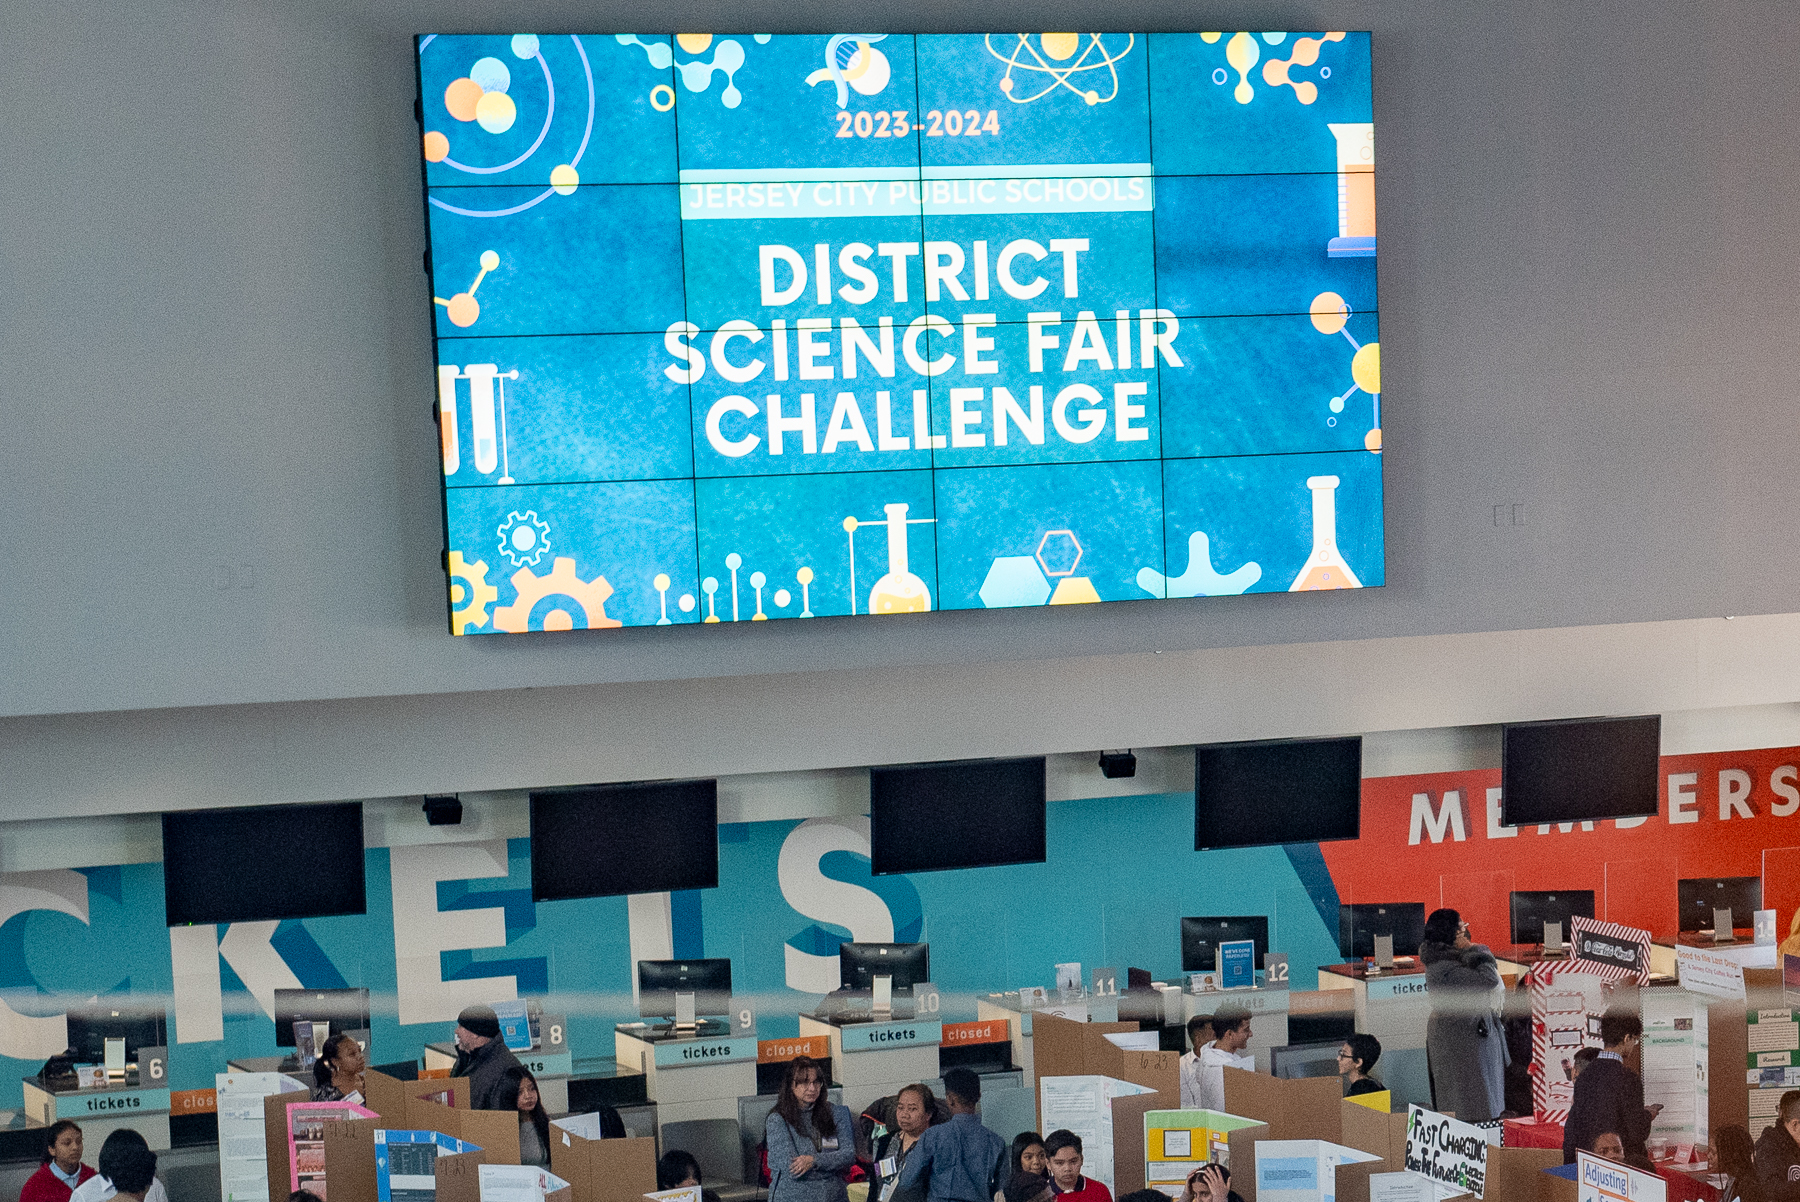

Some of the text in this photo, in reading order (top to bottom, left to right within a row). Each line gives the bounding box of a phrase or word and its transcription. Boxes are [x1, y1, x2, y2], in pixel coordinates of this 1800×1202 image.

[835, 110, 1000, 138] 2023-2024
[688, 176, 1145, 210] JERSEY CITY PUBLIC SCHOOLS
[758, 238, 1090, 307] DISTRICT
[663, 308, 1184, 384] SCIENCE FAIR
[705, 382, 1150, 457] CHALLENGE
[1268, 962, 1290, 982] 12
[1097, 977, 1117, 997] 11
[917, 993, 939, 1013] 10
[740, 1010, 751, 1028] 9
[550, 1025, 563, 1044] 8
[869, 1028, 916, 1043] tickets
[948, 1026, 991, 1040] closed
[683, 1043, 731, 1059] tickets
[766, 1042, 811, 1057] closed
[150, 1058, 163, 1079] 6
[87, 1095, 140, 1111] tickets
[1584, 1162, 1626, 1194] Adjusting
